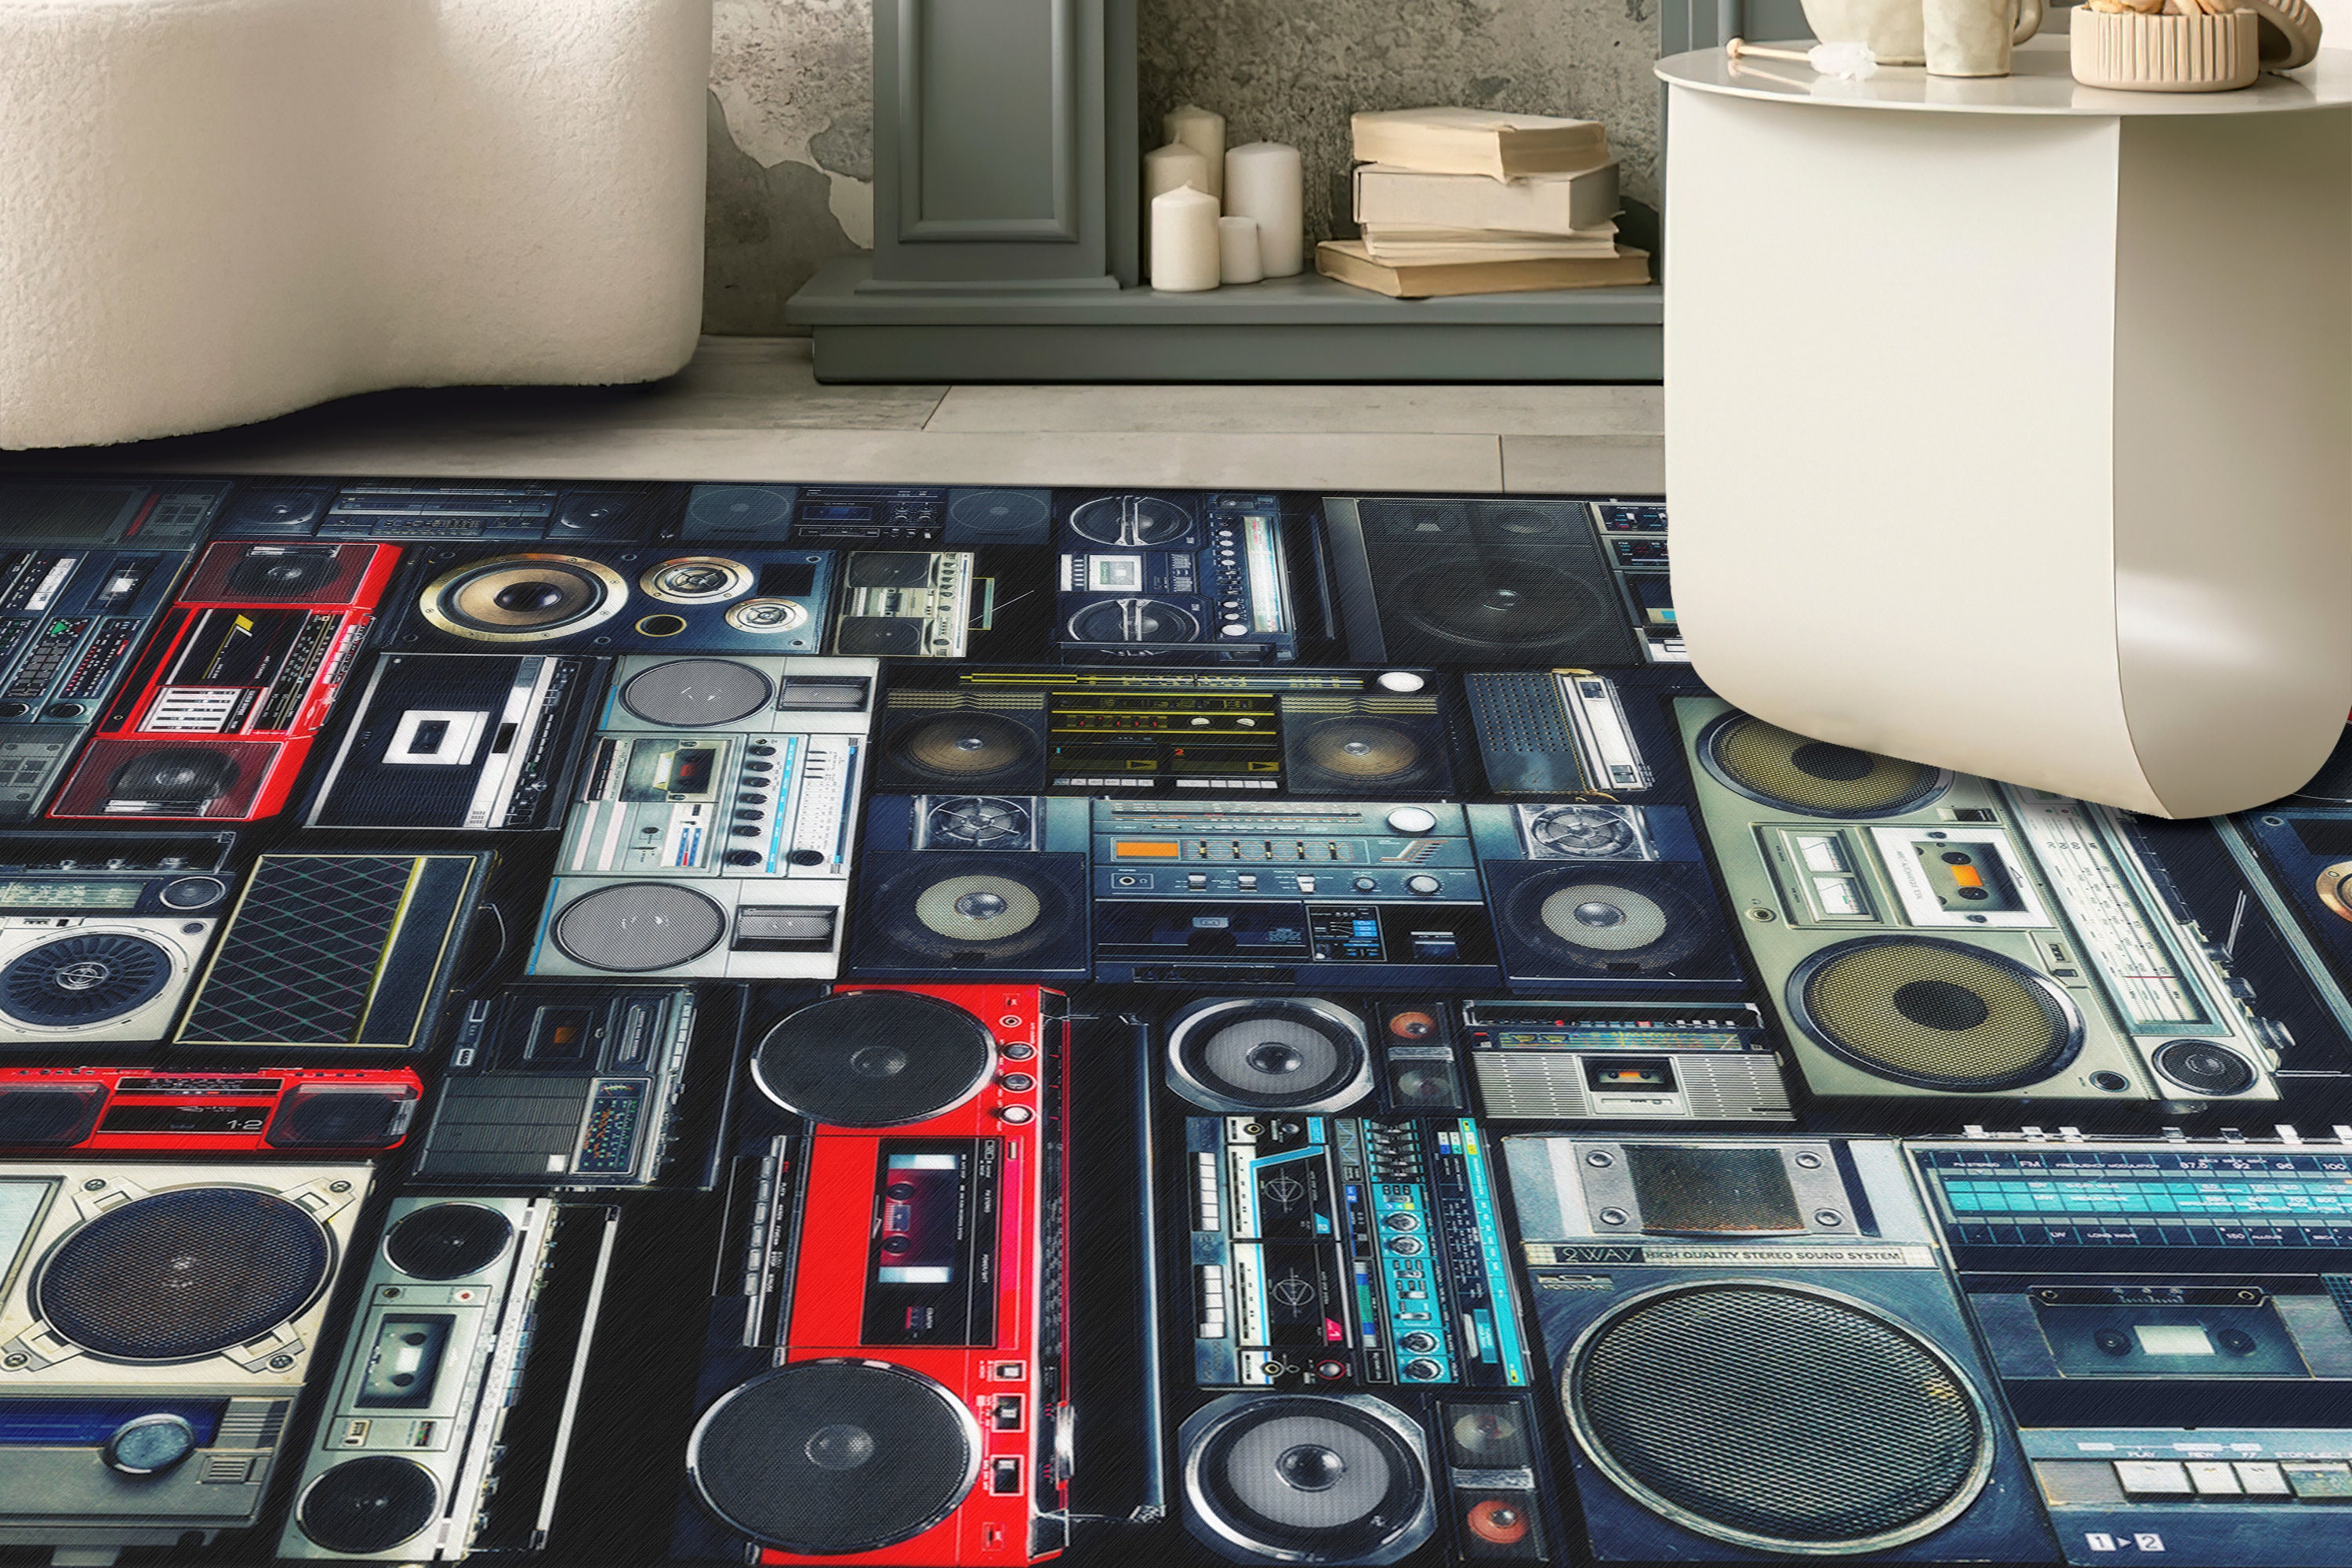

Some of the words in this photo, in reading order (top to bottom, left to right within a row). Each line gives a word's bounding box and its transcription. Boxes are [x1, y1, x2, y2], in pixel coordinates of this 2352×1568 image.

[1646, 1250, 1682, 1260] HIGH
[1683, 1250, 1738, 1260] QUALITY
[1742, 1251, 1794, 1260] STEREO
[1847, 1252, 1900, 1261] SYSTEM
